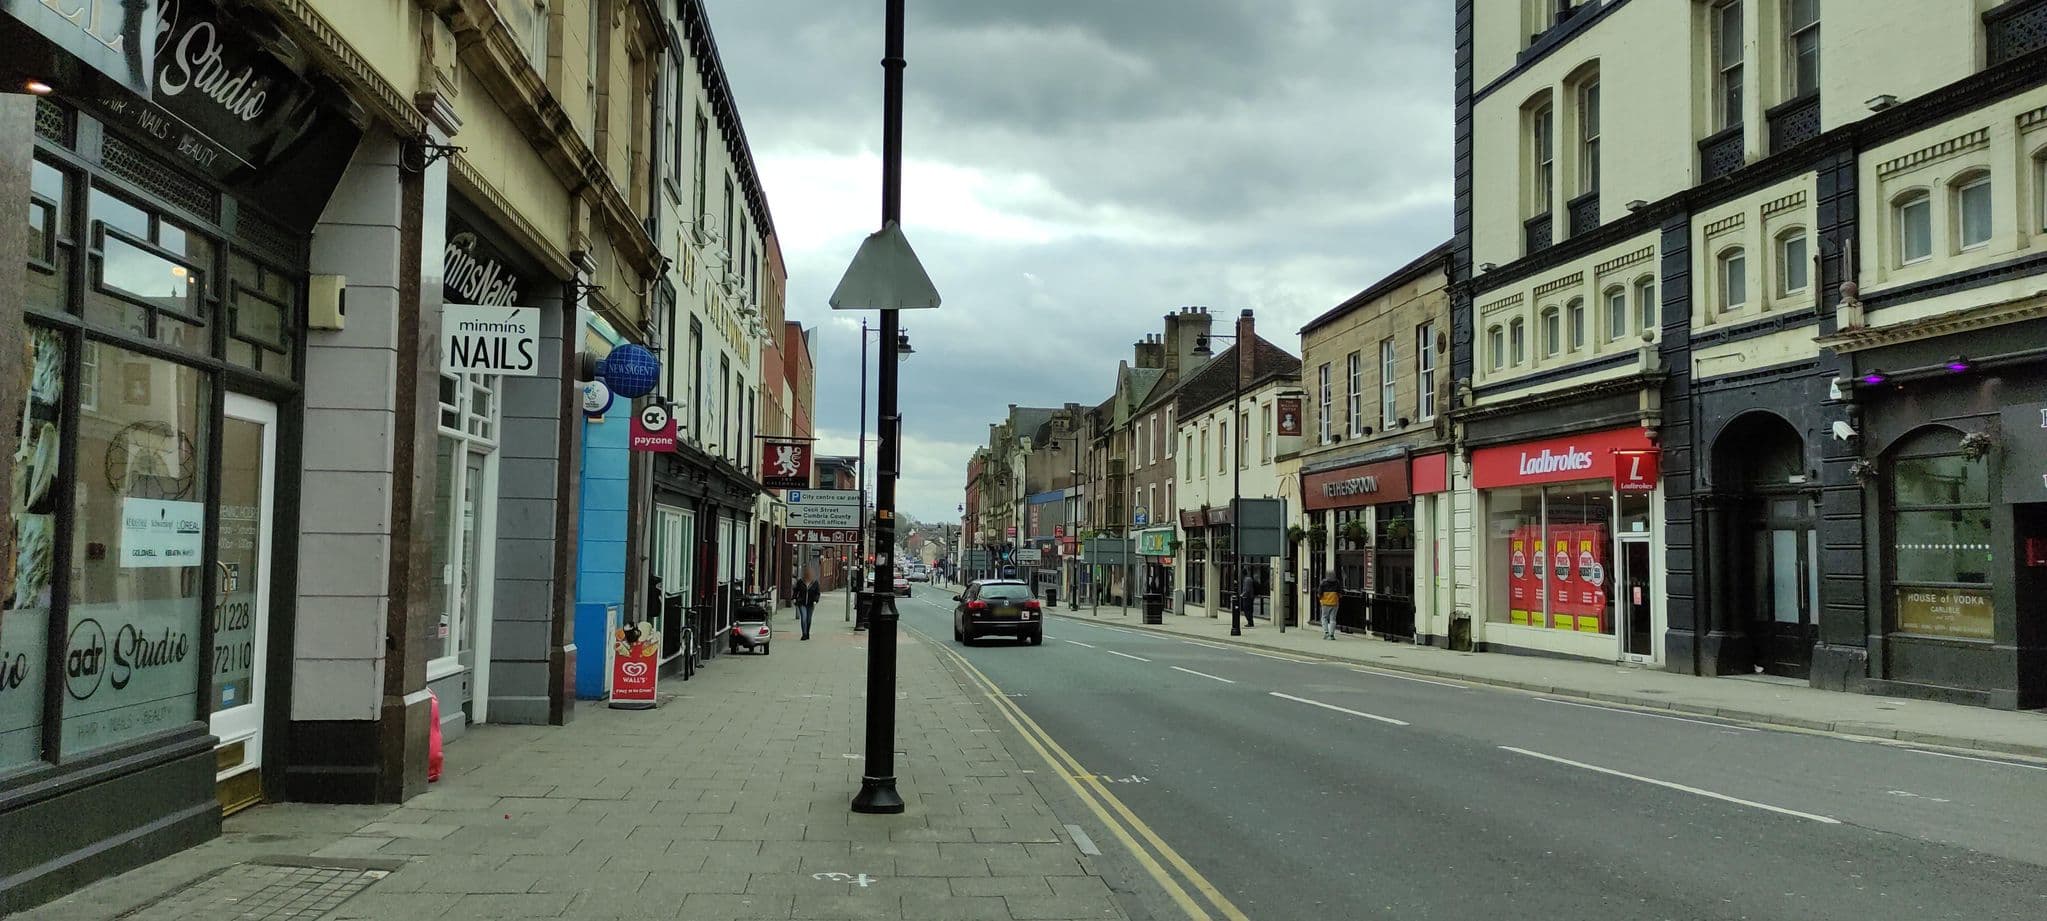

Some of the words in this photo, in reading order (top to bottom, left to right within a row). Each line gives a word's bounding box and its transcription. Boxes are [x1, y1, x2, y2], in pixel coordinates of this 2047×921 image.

[159, 21, 267, 121] Studio
[137, 108, 170, 139] NAILS
[177, 133, 218, 167] BEAUTY
[459, 318, 526, 334] minmins
[450, 335, 533, 371] NAILS
[608, 363, 655, 377] NEWSAGENT
[634, 437, 673, 446] payzone
[1520, 446, 1593, 476] Ladbrokes
[1629, 456, 1643, 481] L
[1322, 475, 1378, 498] WETHERSPOON
[1621, 482, 1653, 490] Ladbrokes
[1907, 593, 1937, 603] HOUSE
[1940, 594, 1950, 603] of
[1953, 595, 1985, 605] VODKA
[213, 602, 250, 635] 01228
[67, 634, 104, 678] adr
[111, 623, 189, 690] Studio
[213, 641, 252, 676] 72110
